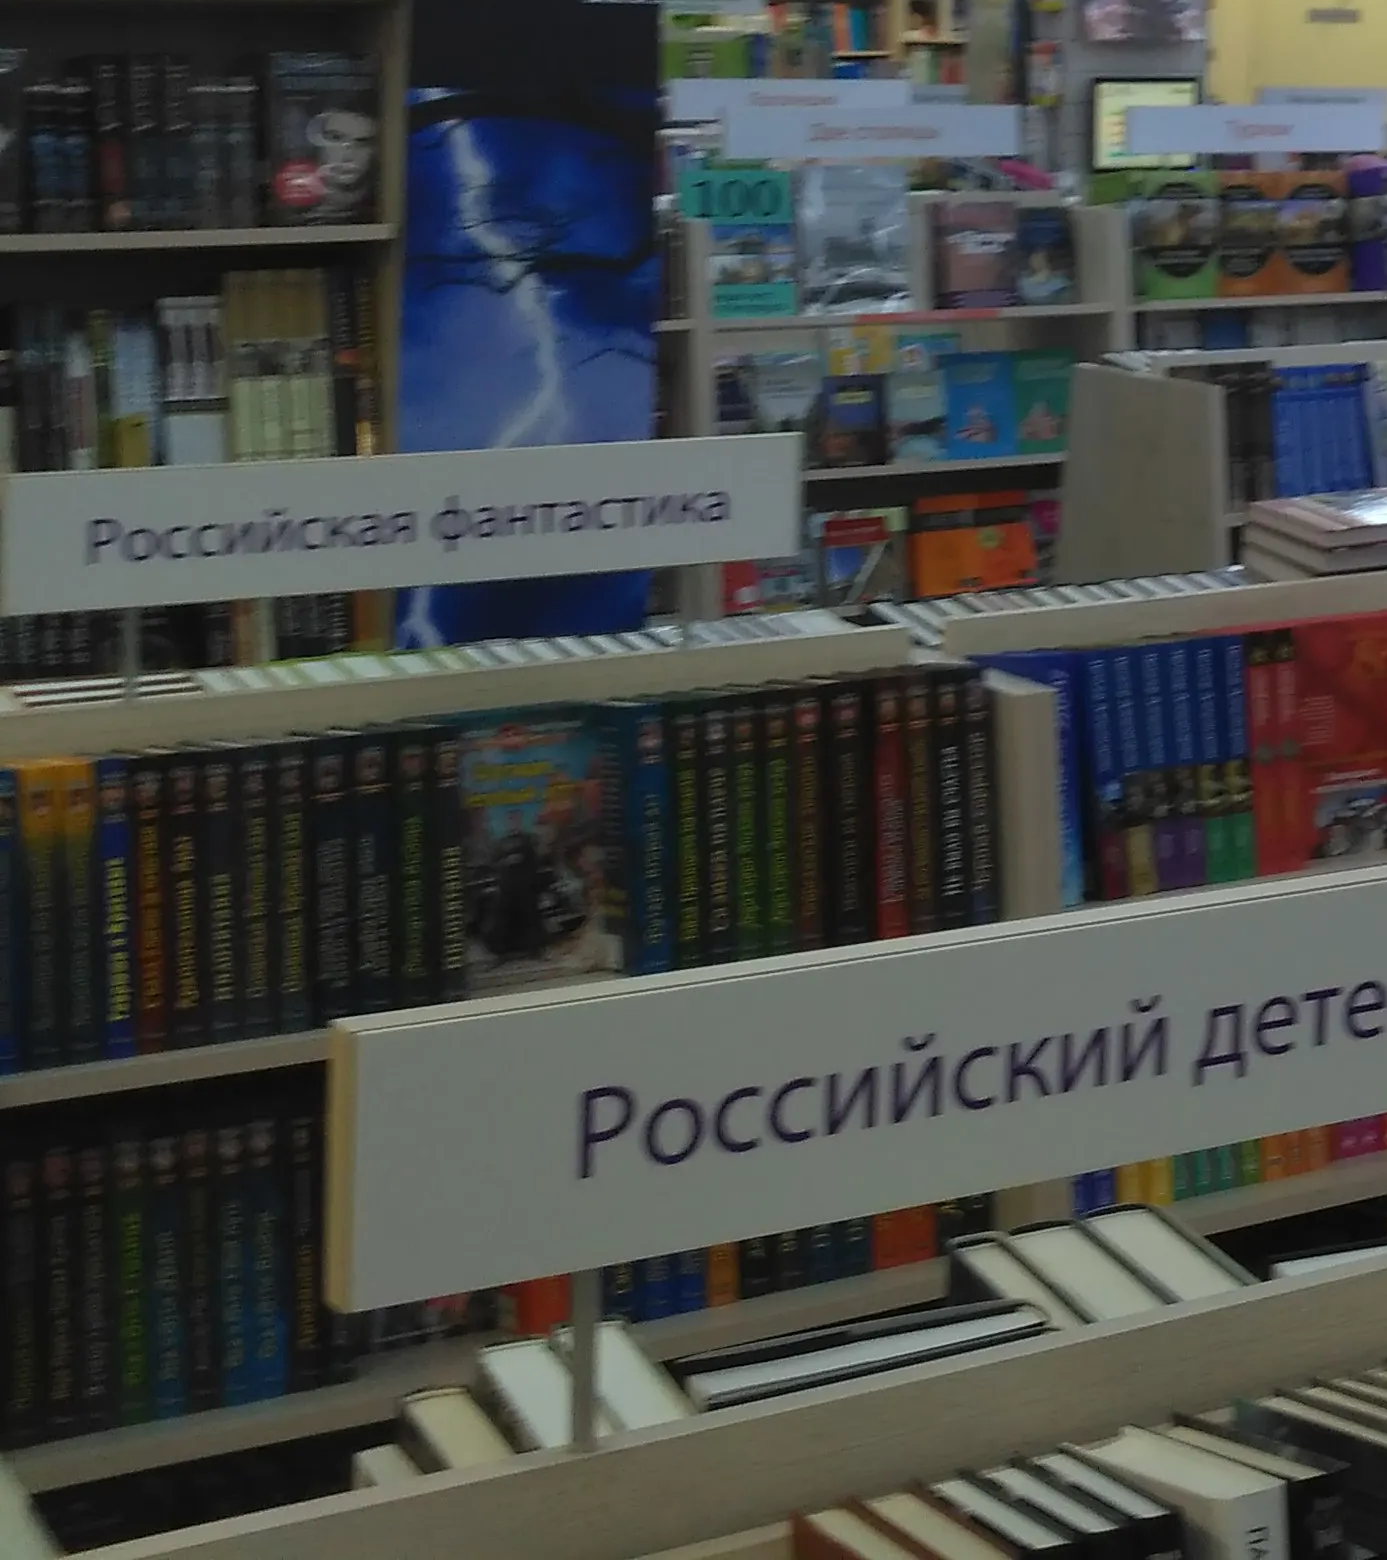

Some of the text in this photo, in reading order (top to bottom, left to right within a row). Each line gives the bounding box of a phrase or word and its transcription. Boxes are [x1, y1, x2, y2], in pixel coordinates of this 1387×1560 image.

[690, 179, 783, 218] 100
[84, 487, 731, 566] Российская фантастика
[577, 994, 1171, 1180] Российский
